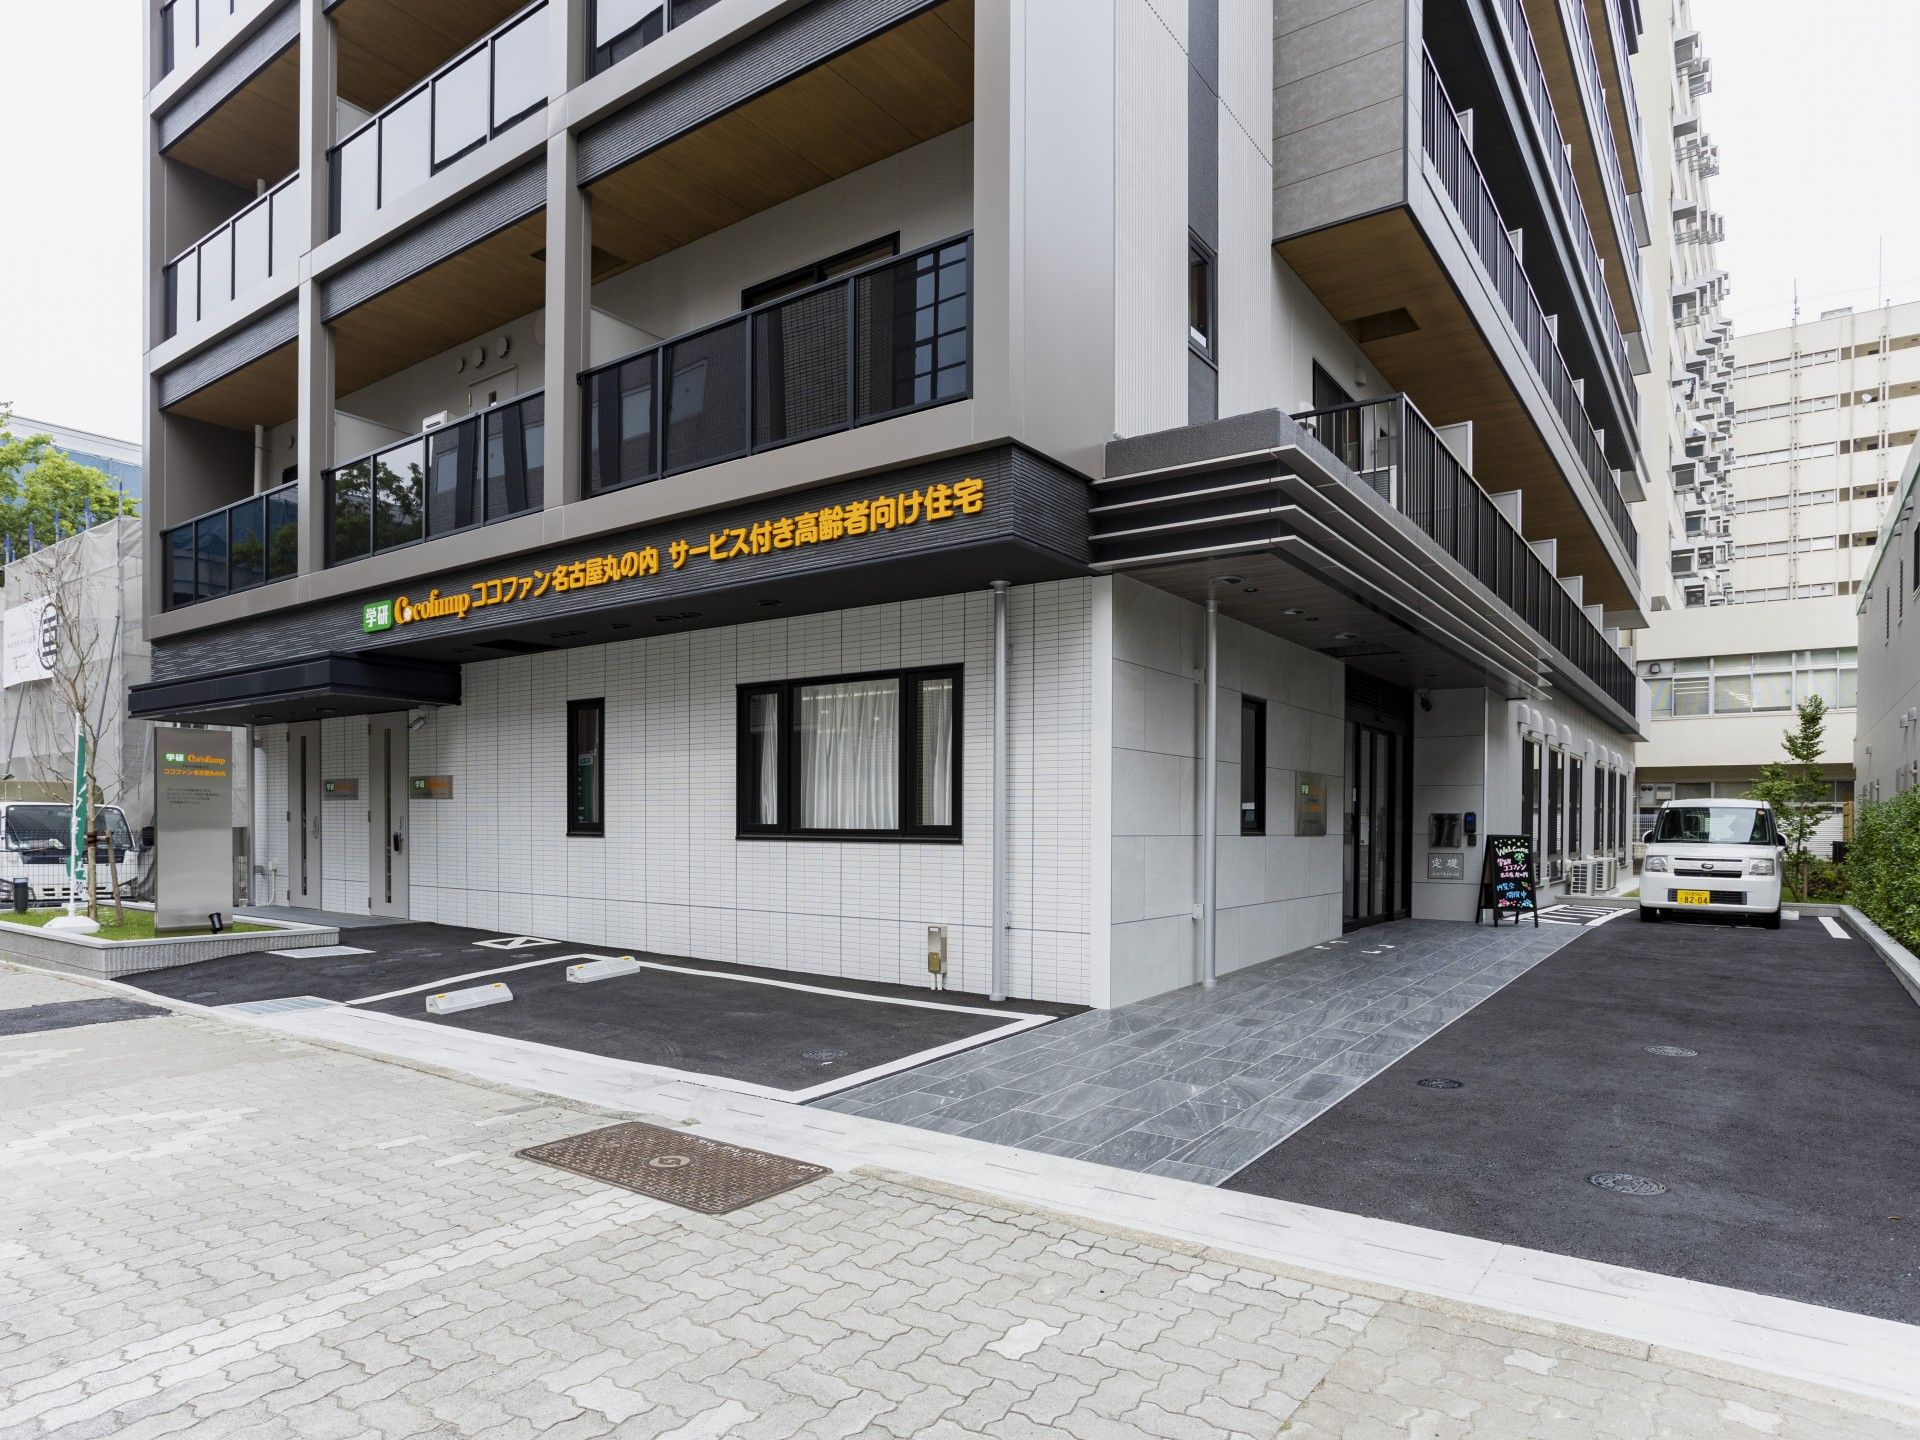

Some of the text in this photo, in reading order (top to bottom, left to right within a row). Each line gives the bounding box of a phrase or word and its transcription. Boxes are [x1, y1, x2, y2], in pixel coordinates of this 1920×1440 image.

[365, 604, 389, 627] 学研
[471, 546, 660, 608] ココファン名古屋丸の内
[668, 477, 985, 570] サービス付き高齢者向け住宅
